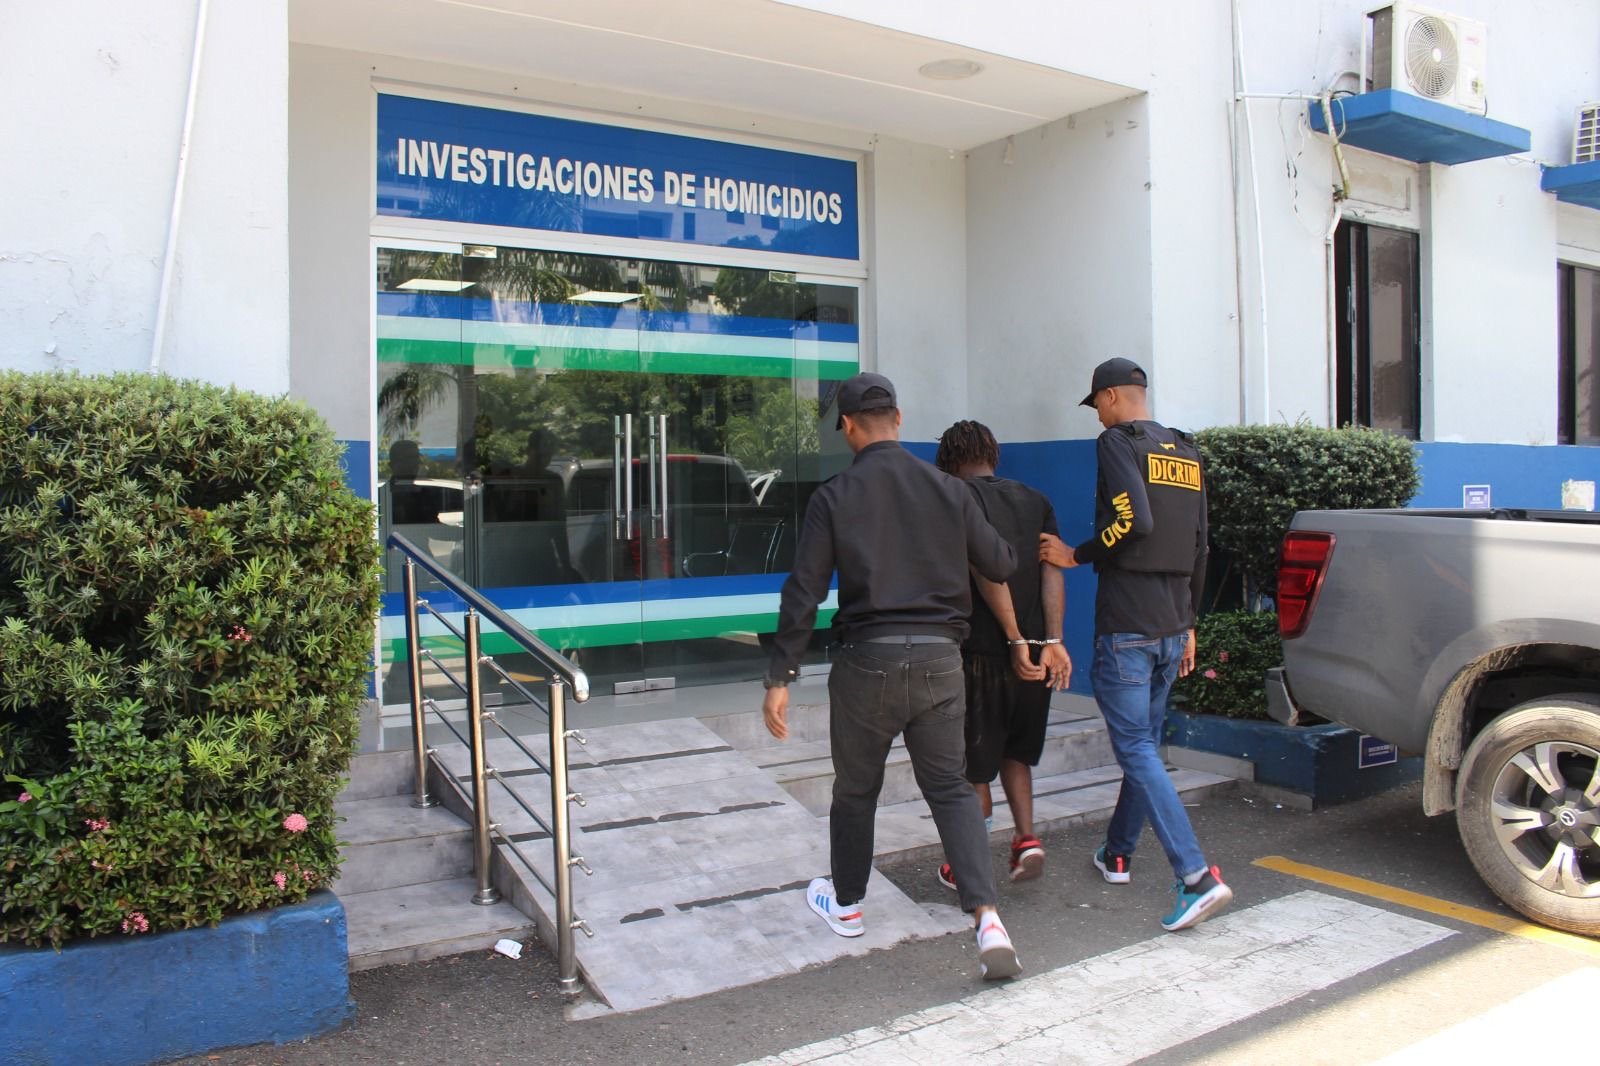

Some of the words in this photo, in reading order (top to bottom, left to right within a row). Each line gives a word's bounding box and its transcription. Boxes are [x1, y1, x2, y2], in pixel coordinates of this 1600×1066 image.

[397, 138, 654, 202] INVESTIGACIONES
[664, 171, 696, 207] DE
[704, 176, 843, 225] HOMICIDIOS
[1151, 458, 1199, 486] DICRIM
